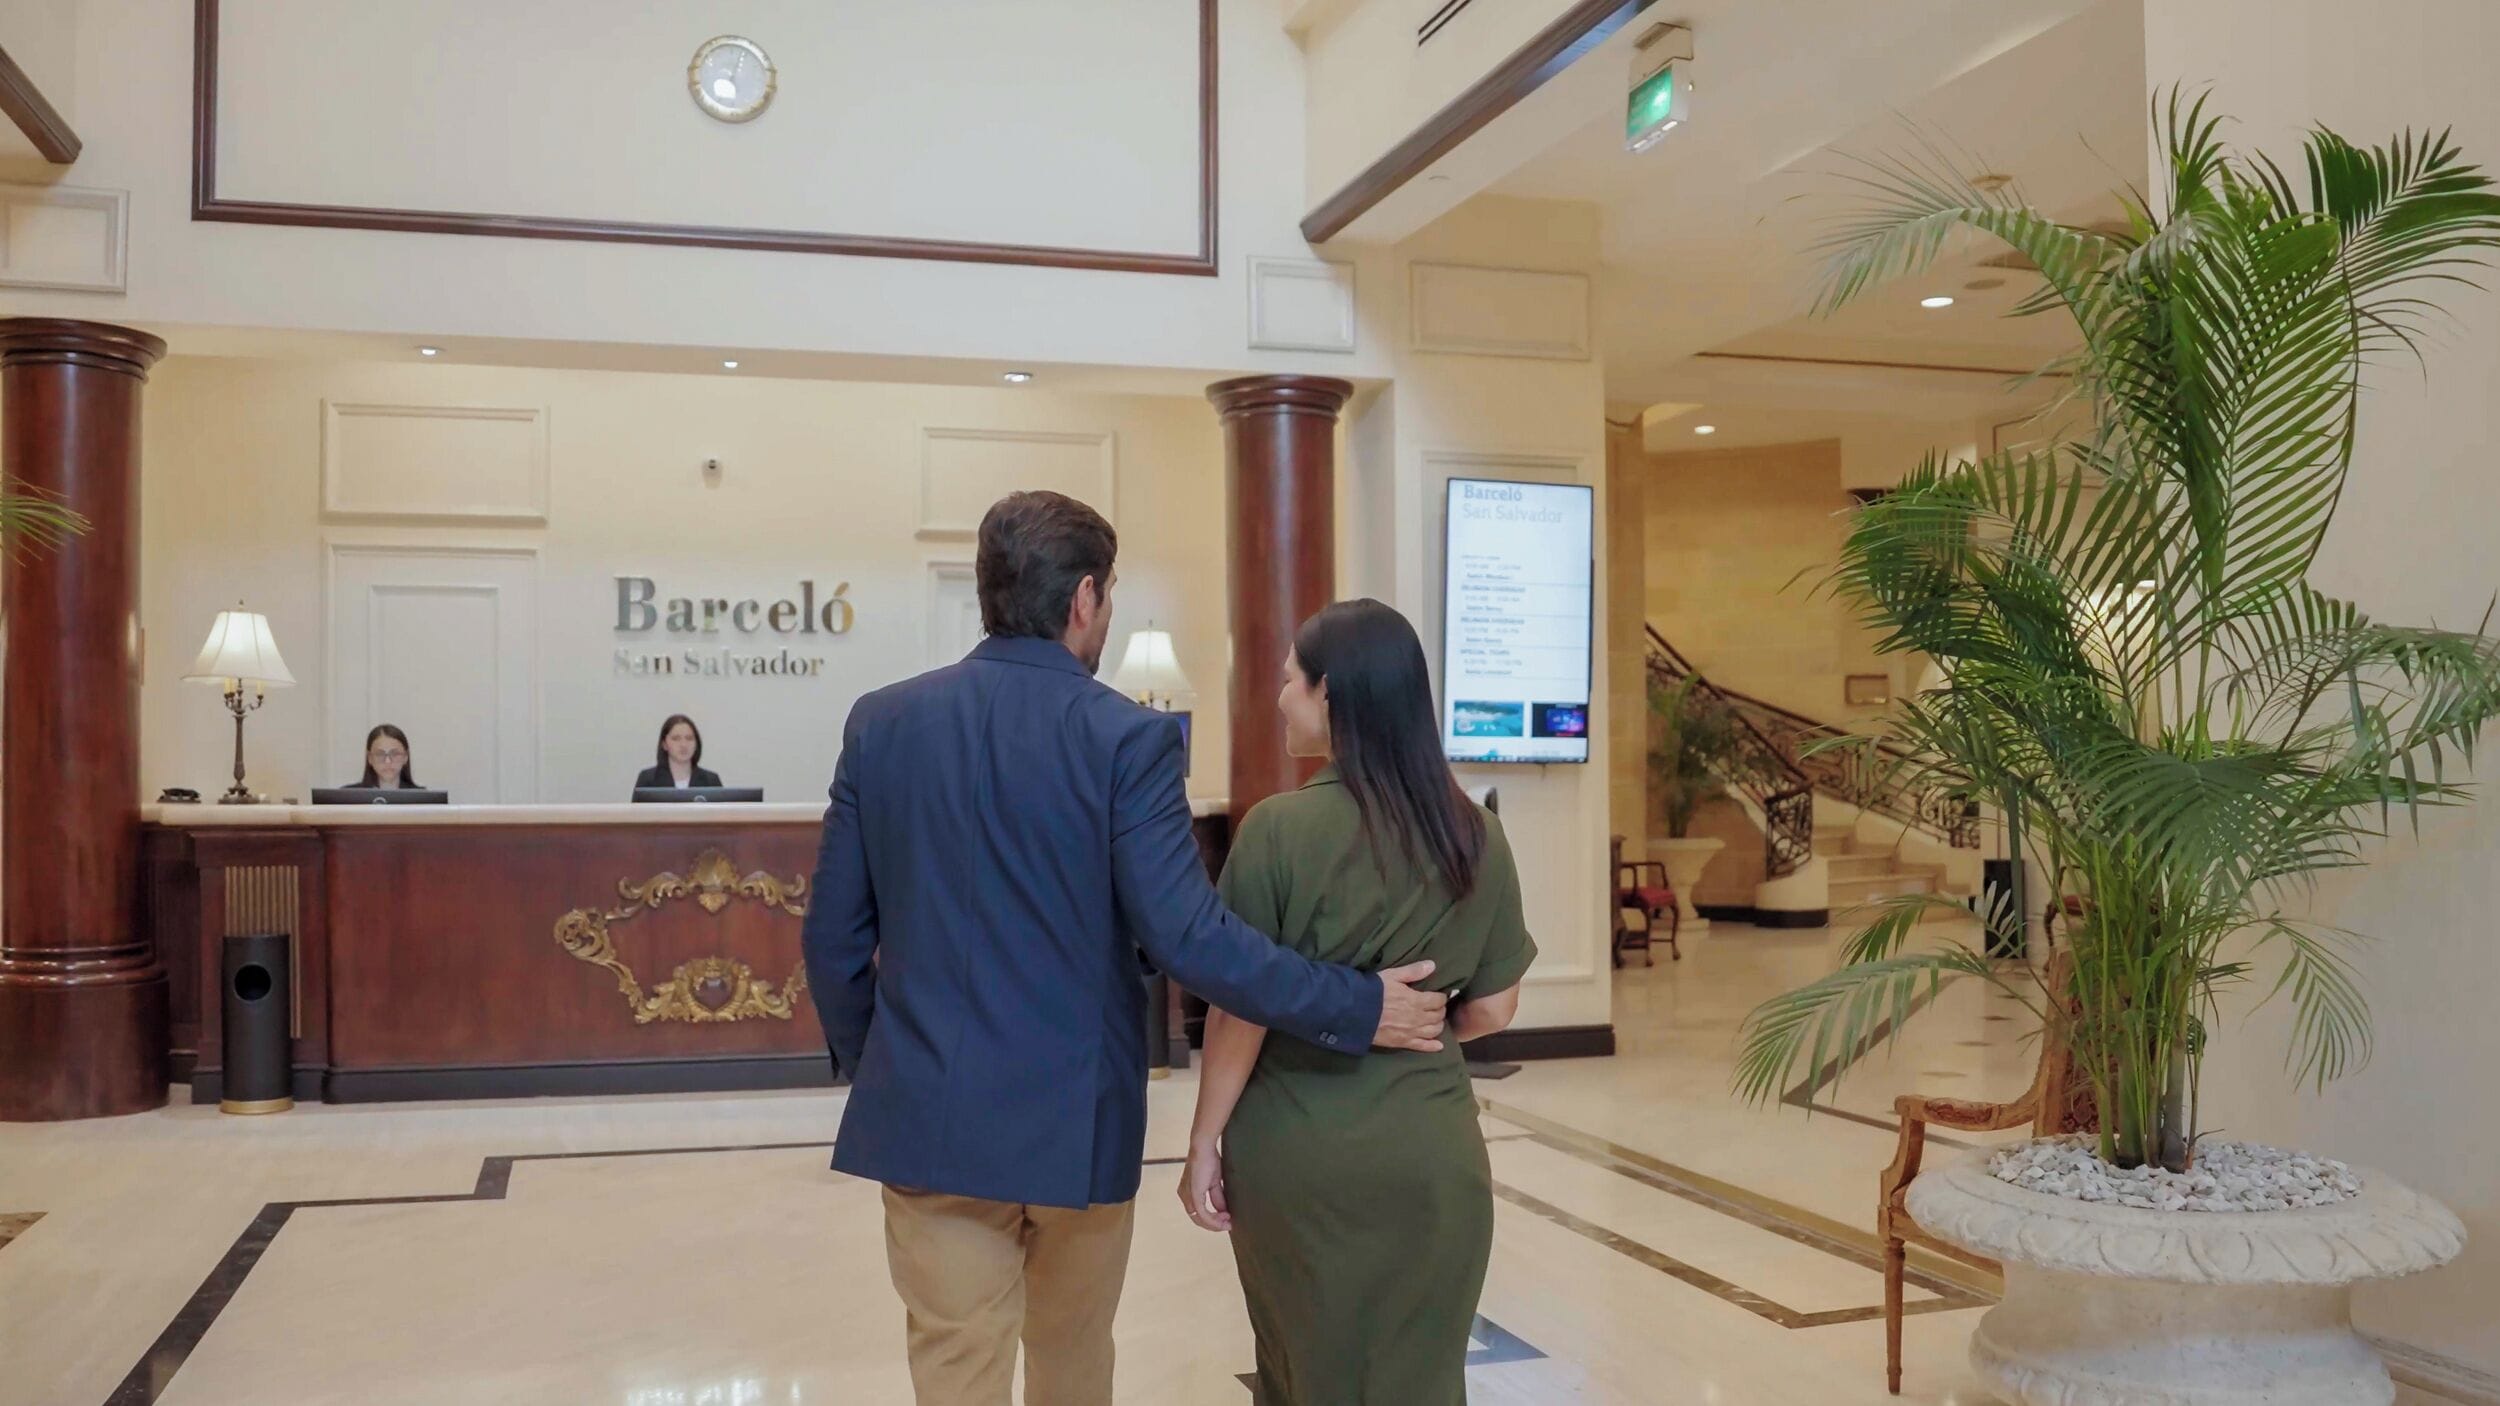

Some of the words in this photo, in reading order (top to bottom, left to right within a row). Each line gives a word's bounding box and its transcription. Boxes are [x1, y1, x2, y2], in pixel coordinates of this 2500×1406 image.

[1464, 484, 1522, 501] Barceló
[1463, 503, 1492, 520] San
[1495, 505, 1563, 523] Salvador
[614, 577, 855, 634] Barceló
[613, 648, 673, 676] San
[684, 647, 825, 677] Salvador
